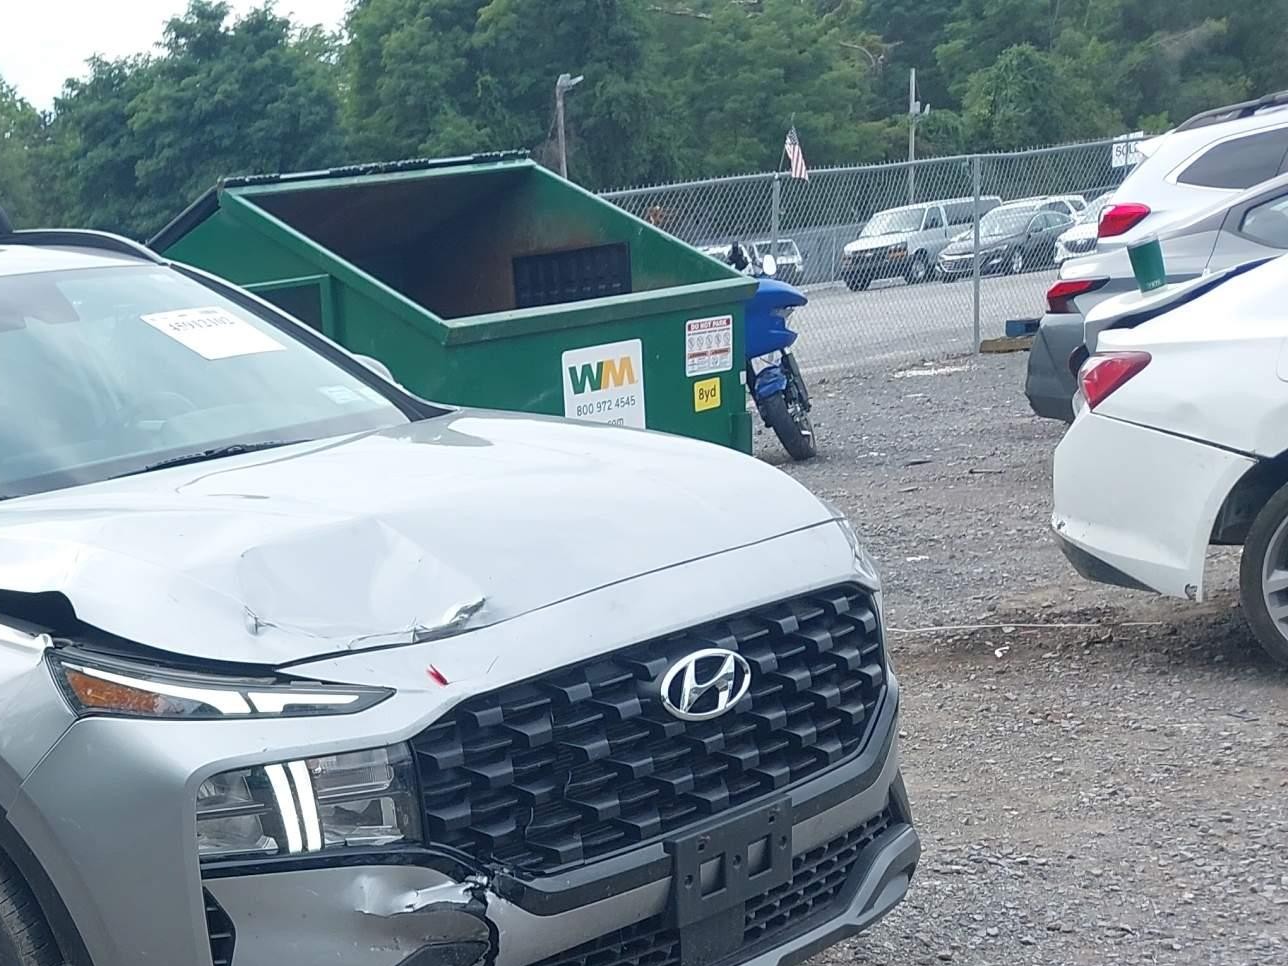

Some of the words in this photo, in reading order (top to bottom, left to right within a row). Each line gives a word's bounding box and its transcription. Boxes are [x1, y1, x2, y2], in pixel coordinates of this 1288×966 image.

[568, 357, 635, 395] WM
[698, 385, 716, 403] 8yd
[576, 403, 594, 417] 800
[596, 400, 613, 413] 972
[615, 395, 636, 408] 4545
